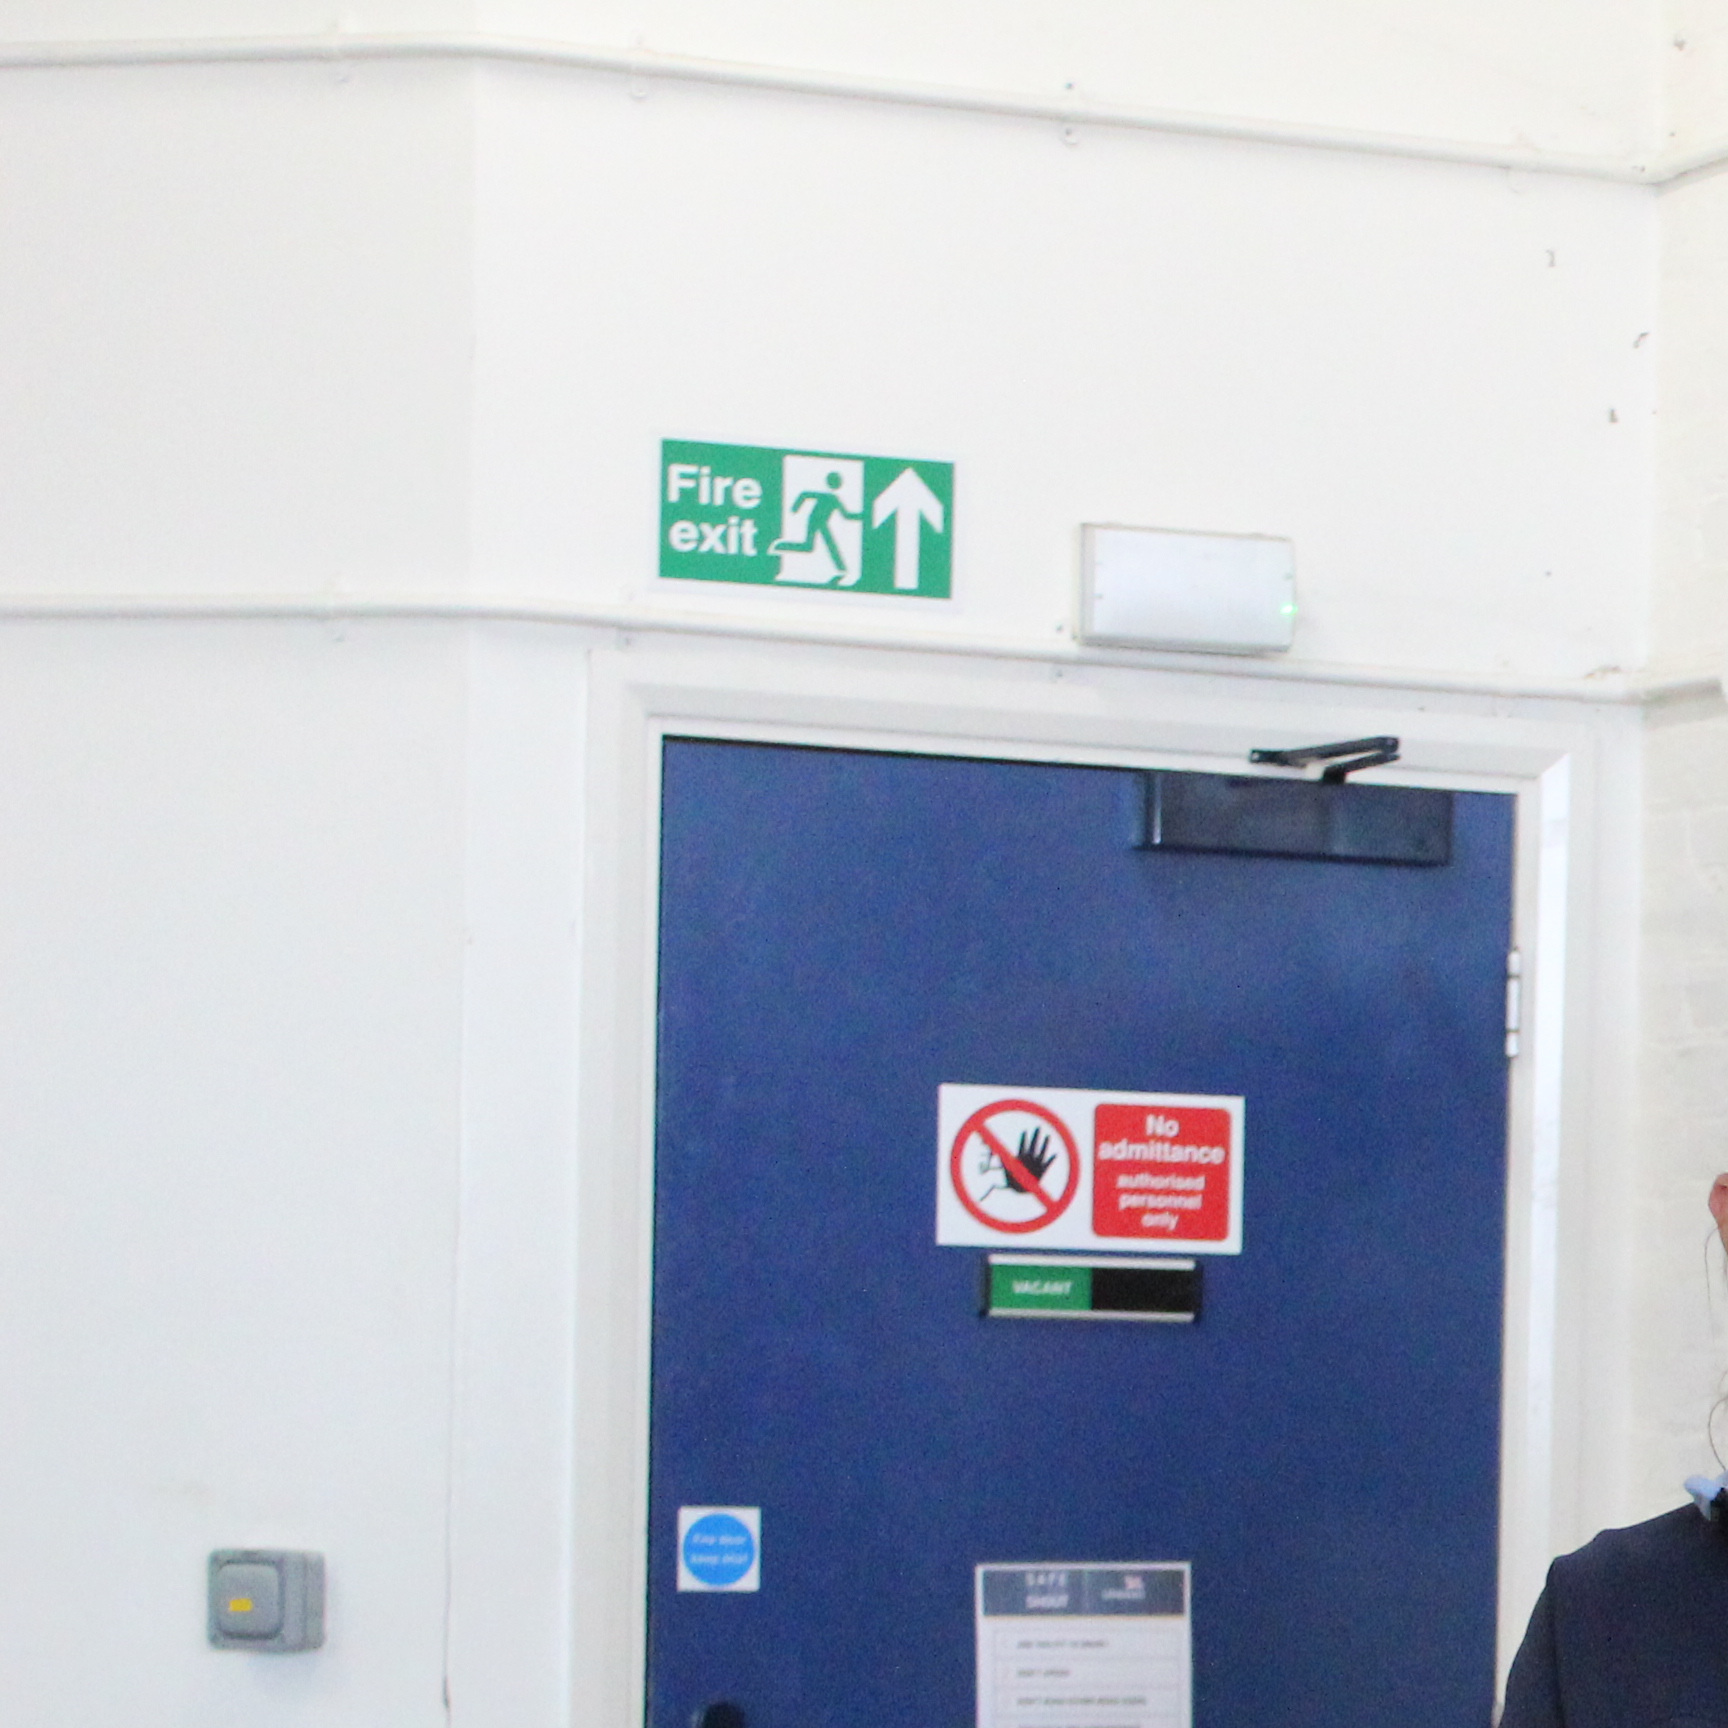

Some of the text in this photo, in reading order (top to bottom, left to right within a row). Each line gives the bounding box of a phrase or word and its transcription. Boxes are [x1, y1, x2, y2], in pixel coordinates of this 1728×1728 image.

[667, 463, 763, 510] Fire
[668, 516, 758, 557] exit
[1146, 1114, 1181, 1137] No
[1098, 1138, 1226, 1165] admittance
[1117, 1173, 1206, 1191] authorised
[1118, 1193, 1203, 1212] personnel
[1140, 1212, 1180, 1231] only
[1012, 1279, 1073, 1296] VACANT
